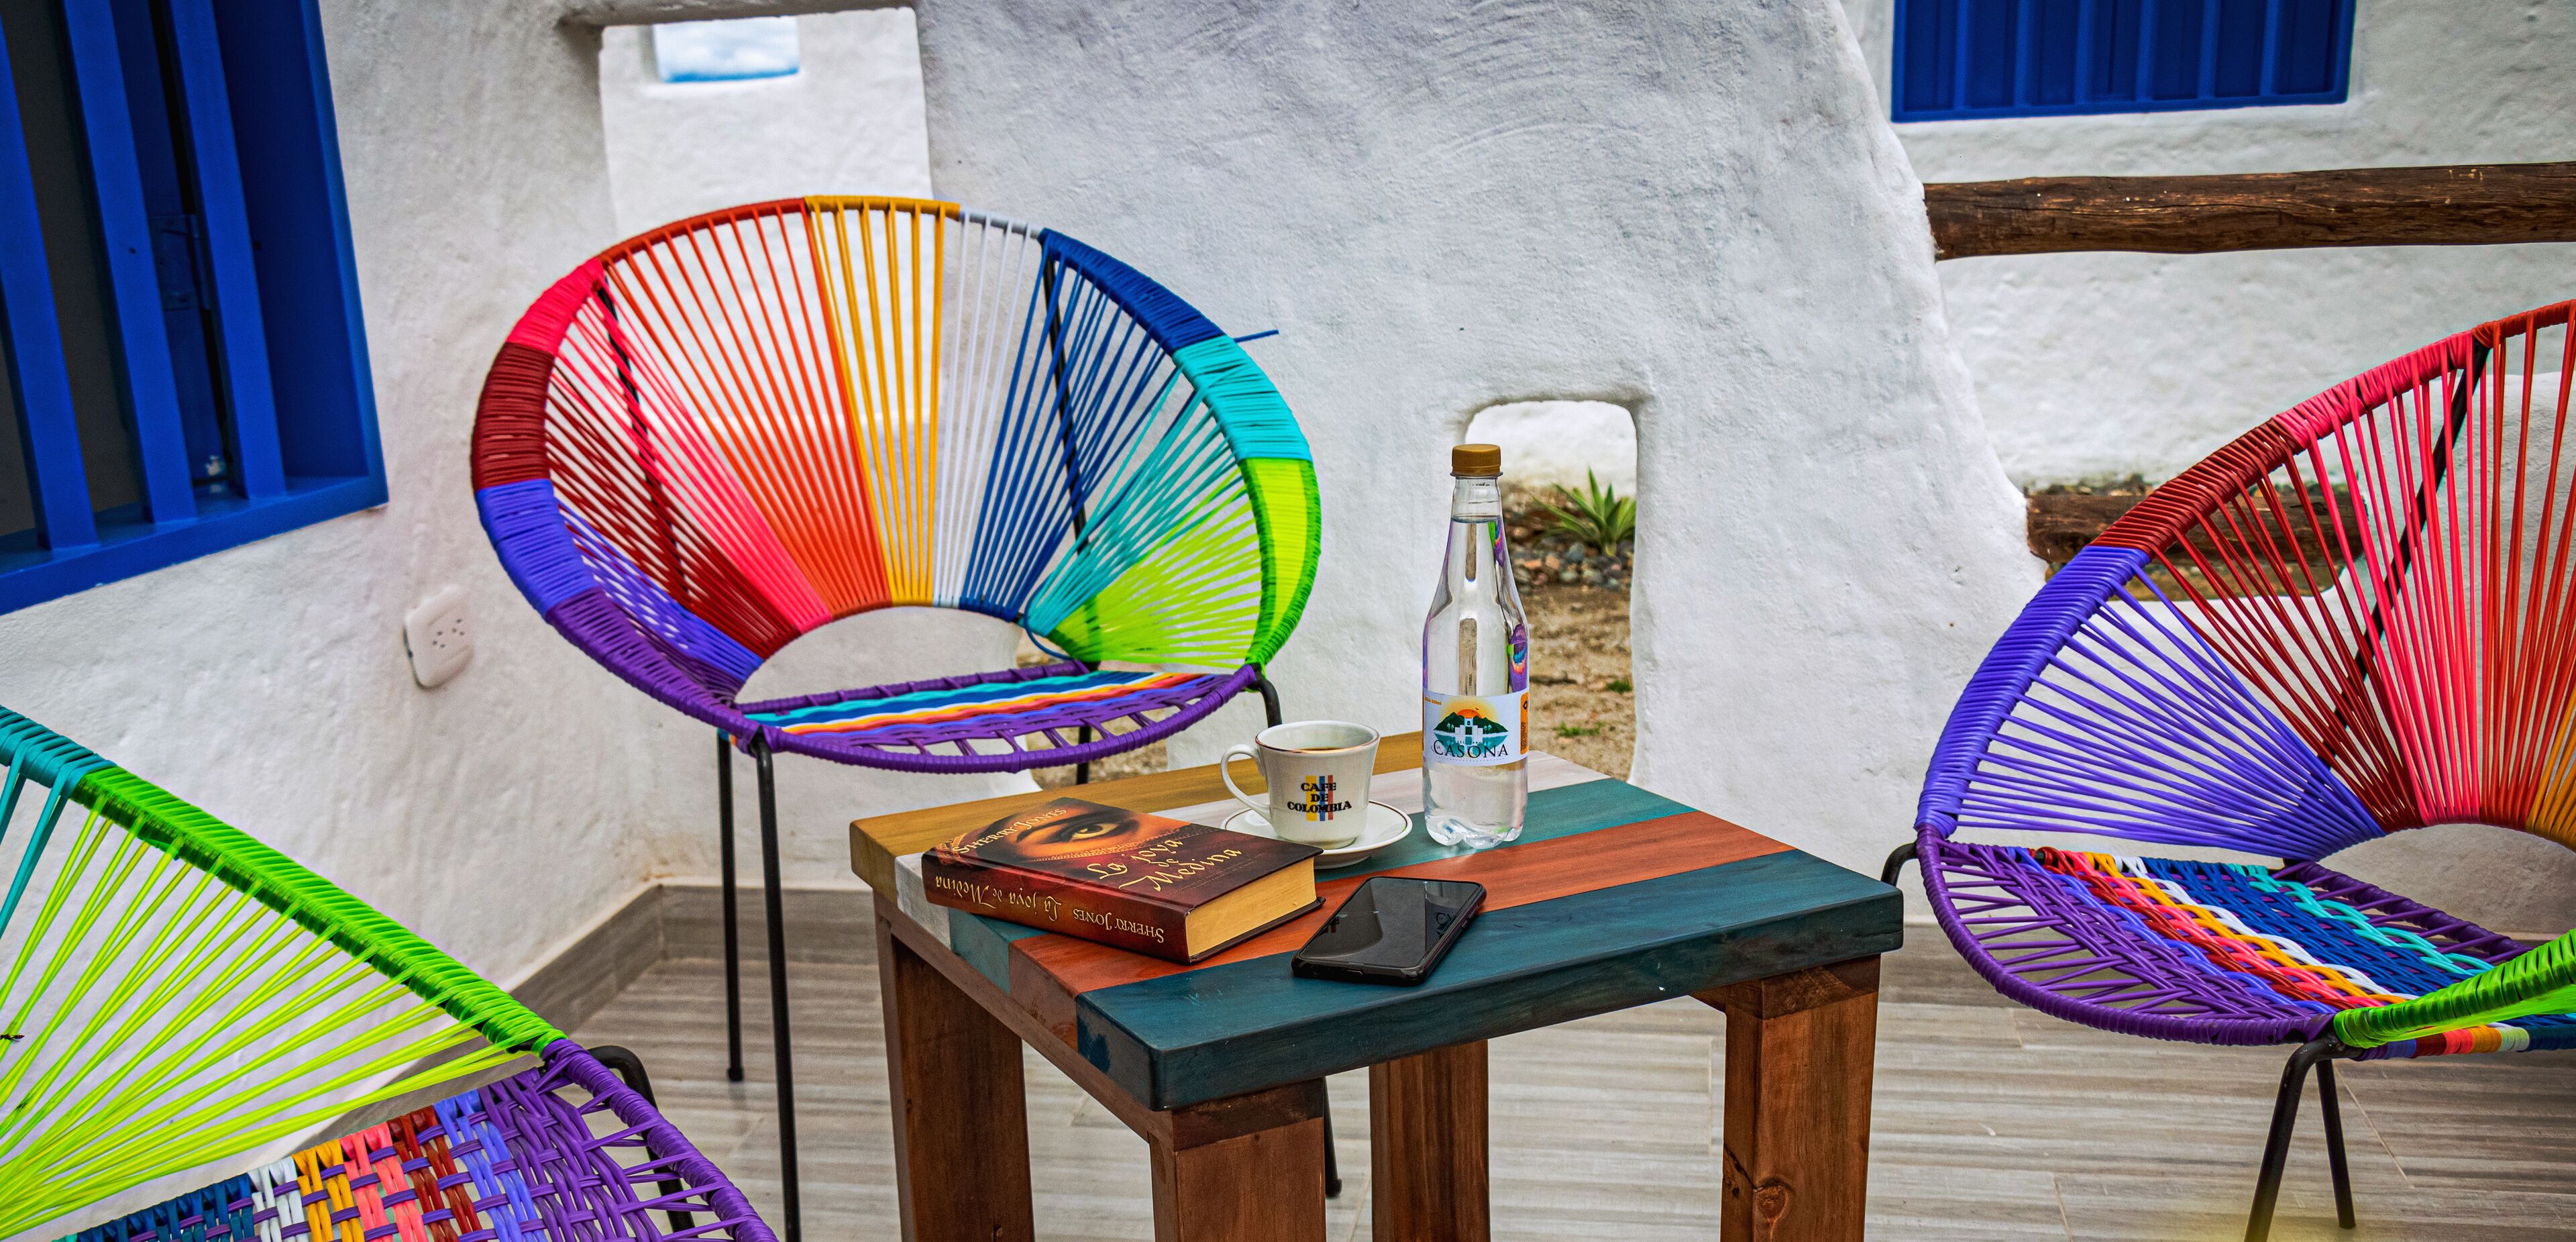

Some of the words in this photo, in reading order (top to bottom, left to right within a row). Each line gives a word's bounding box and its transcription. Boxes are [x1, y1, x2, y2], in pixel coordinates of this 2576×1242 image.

[1433, 739, 1509, 759] CASONA
[1301, 782, 1337, 792] CAFE
[1310, 793, 1329, 803] DE
[1287, 800, 1352, 814] COLOMBIA
[952, 825, 1019, 853] SHERRY
[1014, 809, 1067, 830] JONES
[1087, 862, 1128, 880] La
[1121, 839, 1183, 864] joya
[1118, 848, 1242, 892] Medina
[1150, 858, 1179, 867] de
[935, 875, 998, 909] Medina
[992, 888, 1003, 903] de
[1008, 887, 1038, 915] joya
[1043, 895, 1062, 922] La
[1073, 908, 1112, 931] JONES
[1114, 918, 1165, 943] SHERRY
